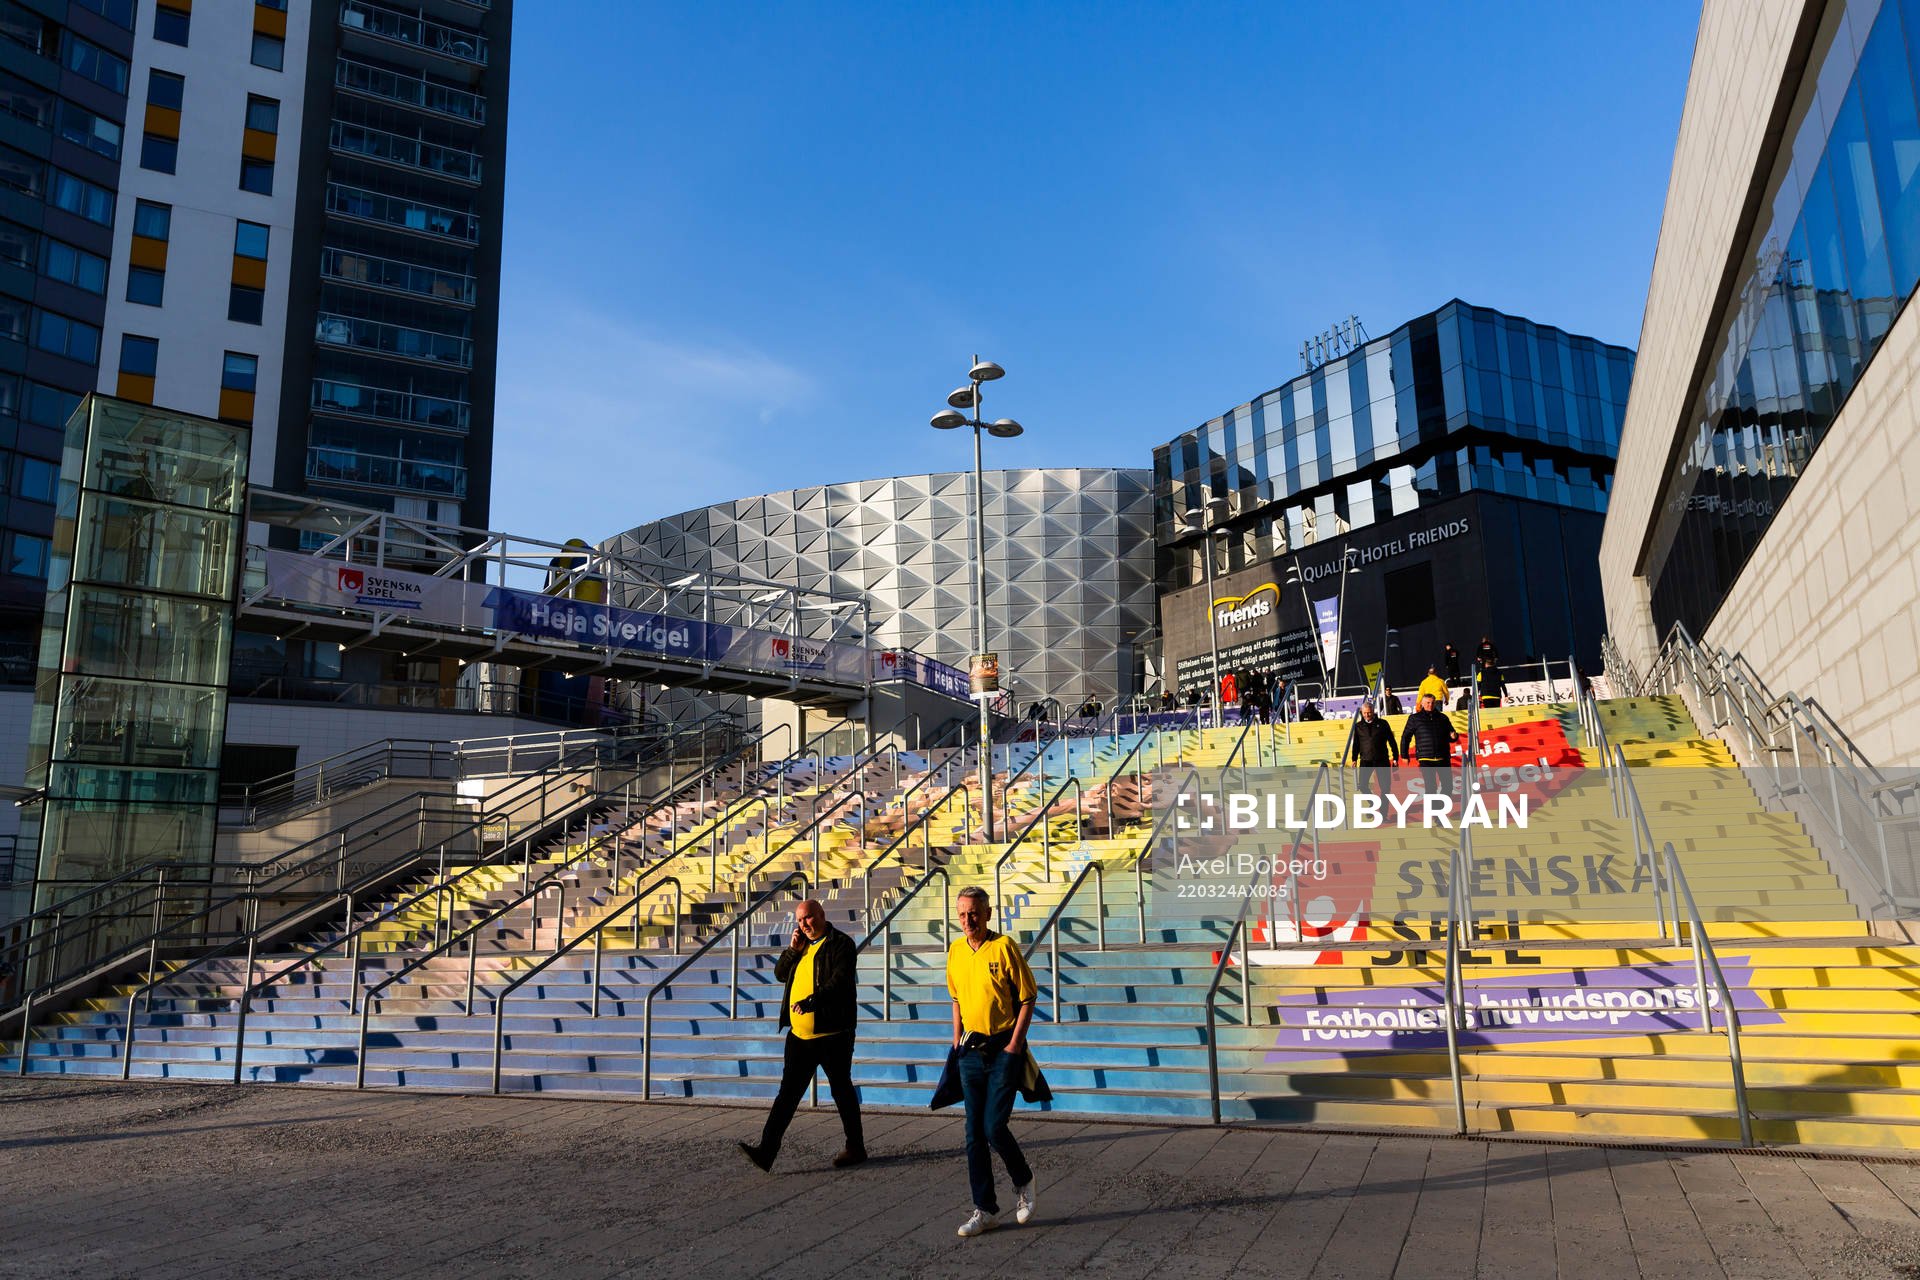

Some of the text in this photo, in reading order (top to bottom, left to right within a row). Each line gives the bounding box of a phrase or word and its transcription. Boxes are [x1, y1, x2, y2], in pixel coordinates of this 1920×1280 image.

[1361, 540, 1406, 565] HOTEL
[1409, 518, 1470, 549] FRIENDS
[367, 576, 422, 594] SVENSKA
[367, 586, 396, 599] SPEL
[530, 603, 690, 650] Heja Sverige!
[1217, 599, 1271, 628] friends
[1231, 620, 1259, 633] ARENA
[1218, 650, 1228, 659] har
[934, 669, 954, 691] Heja
[1396, 850, 1670, 901] SVENSKA
[1370, 908, 1542, 967] SPEL
[1479, 983, 1721, 1027] huvudsponso
